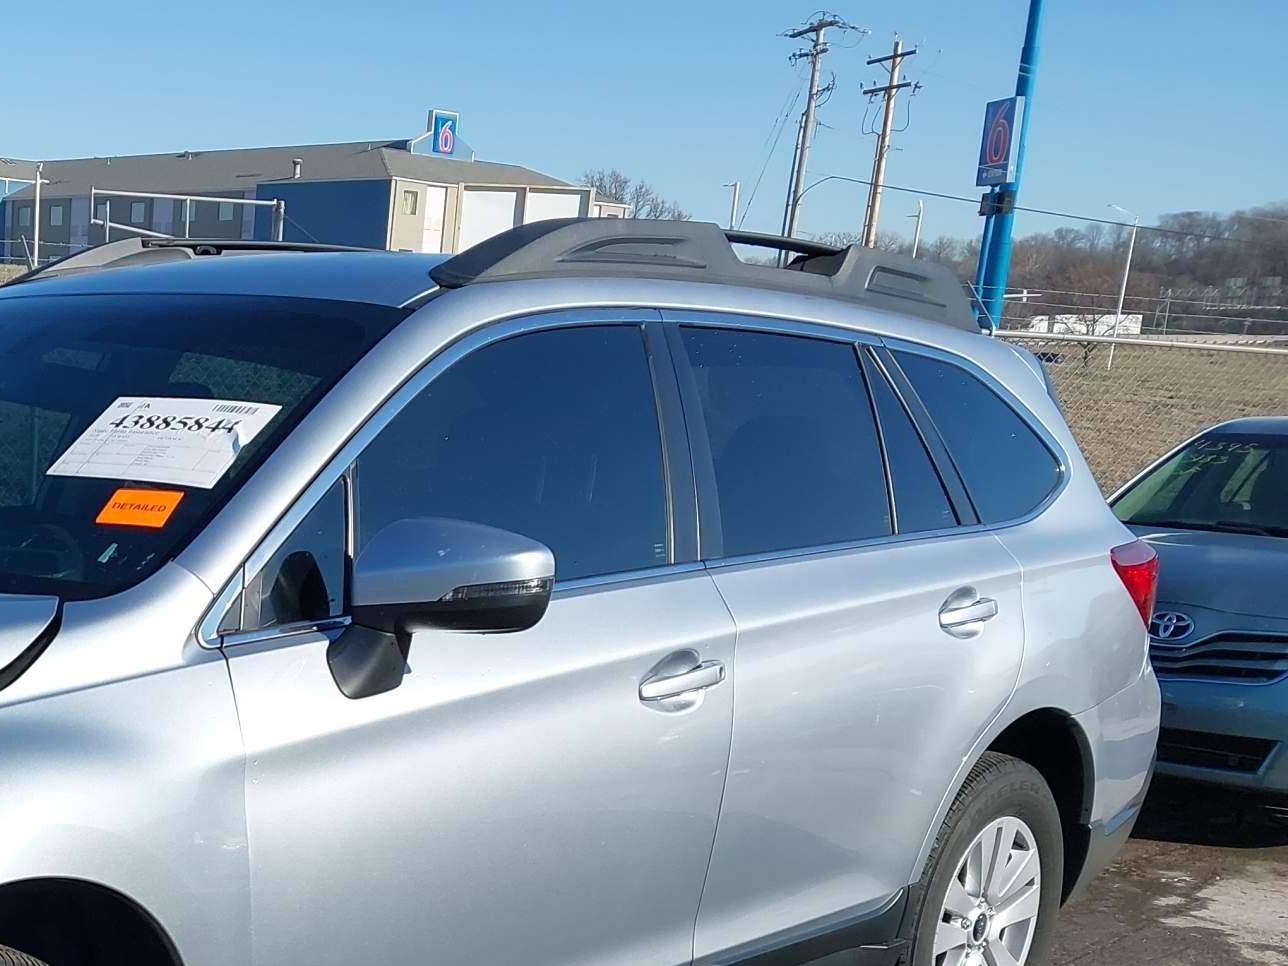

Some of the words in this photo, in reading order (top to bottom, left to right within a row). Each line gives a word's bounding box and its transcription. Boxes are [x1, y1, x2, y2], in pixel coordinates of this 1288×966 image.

[439, 120, 454, 153] 6
[986, 101, 1010, 164] 6
[109, 414, 243, 433] 43885844
[112, 502, 167, 512] DETAILED
